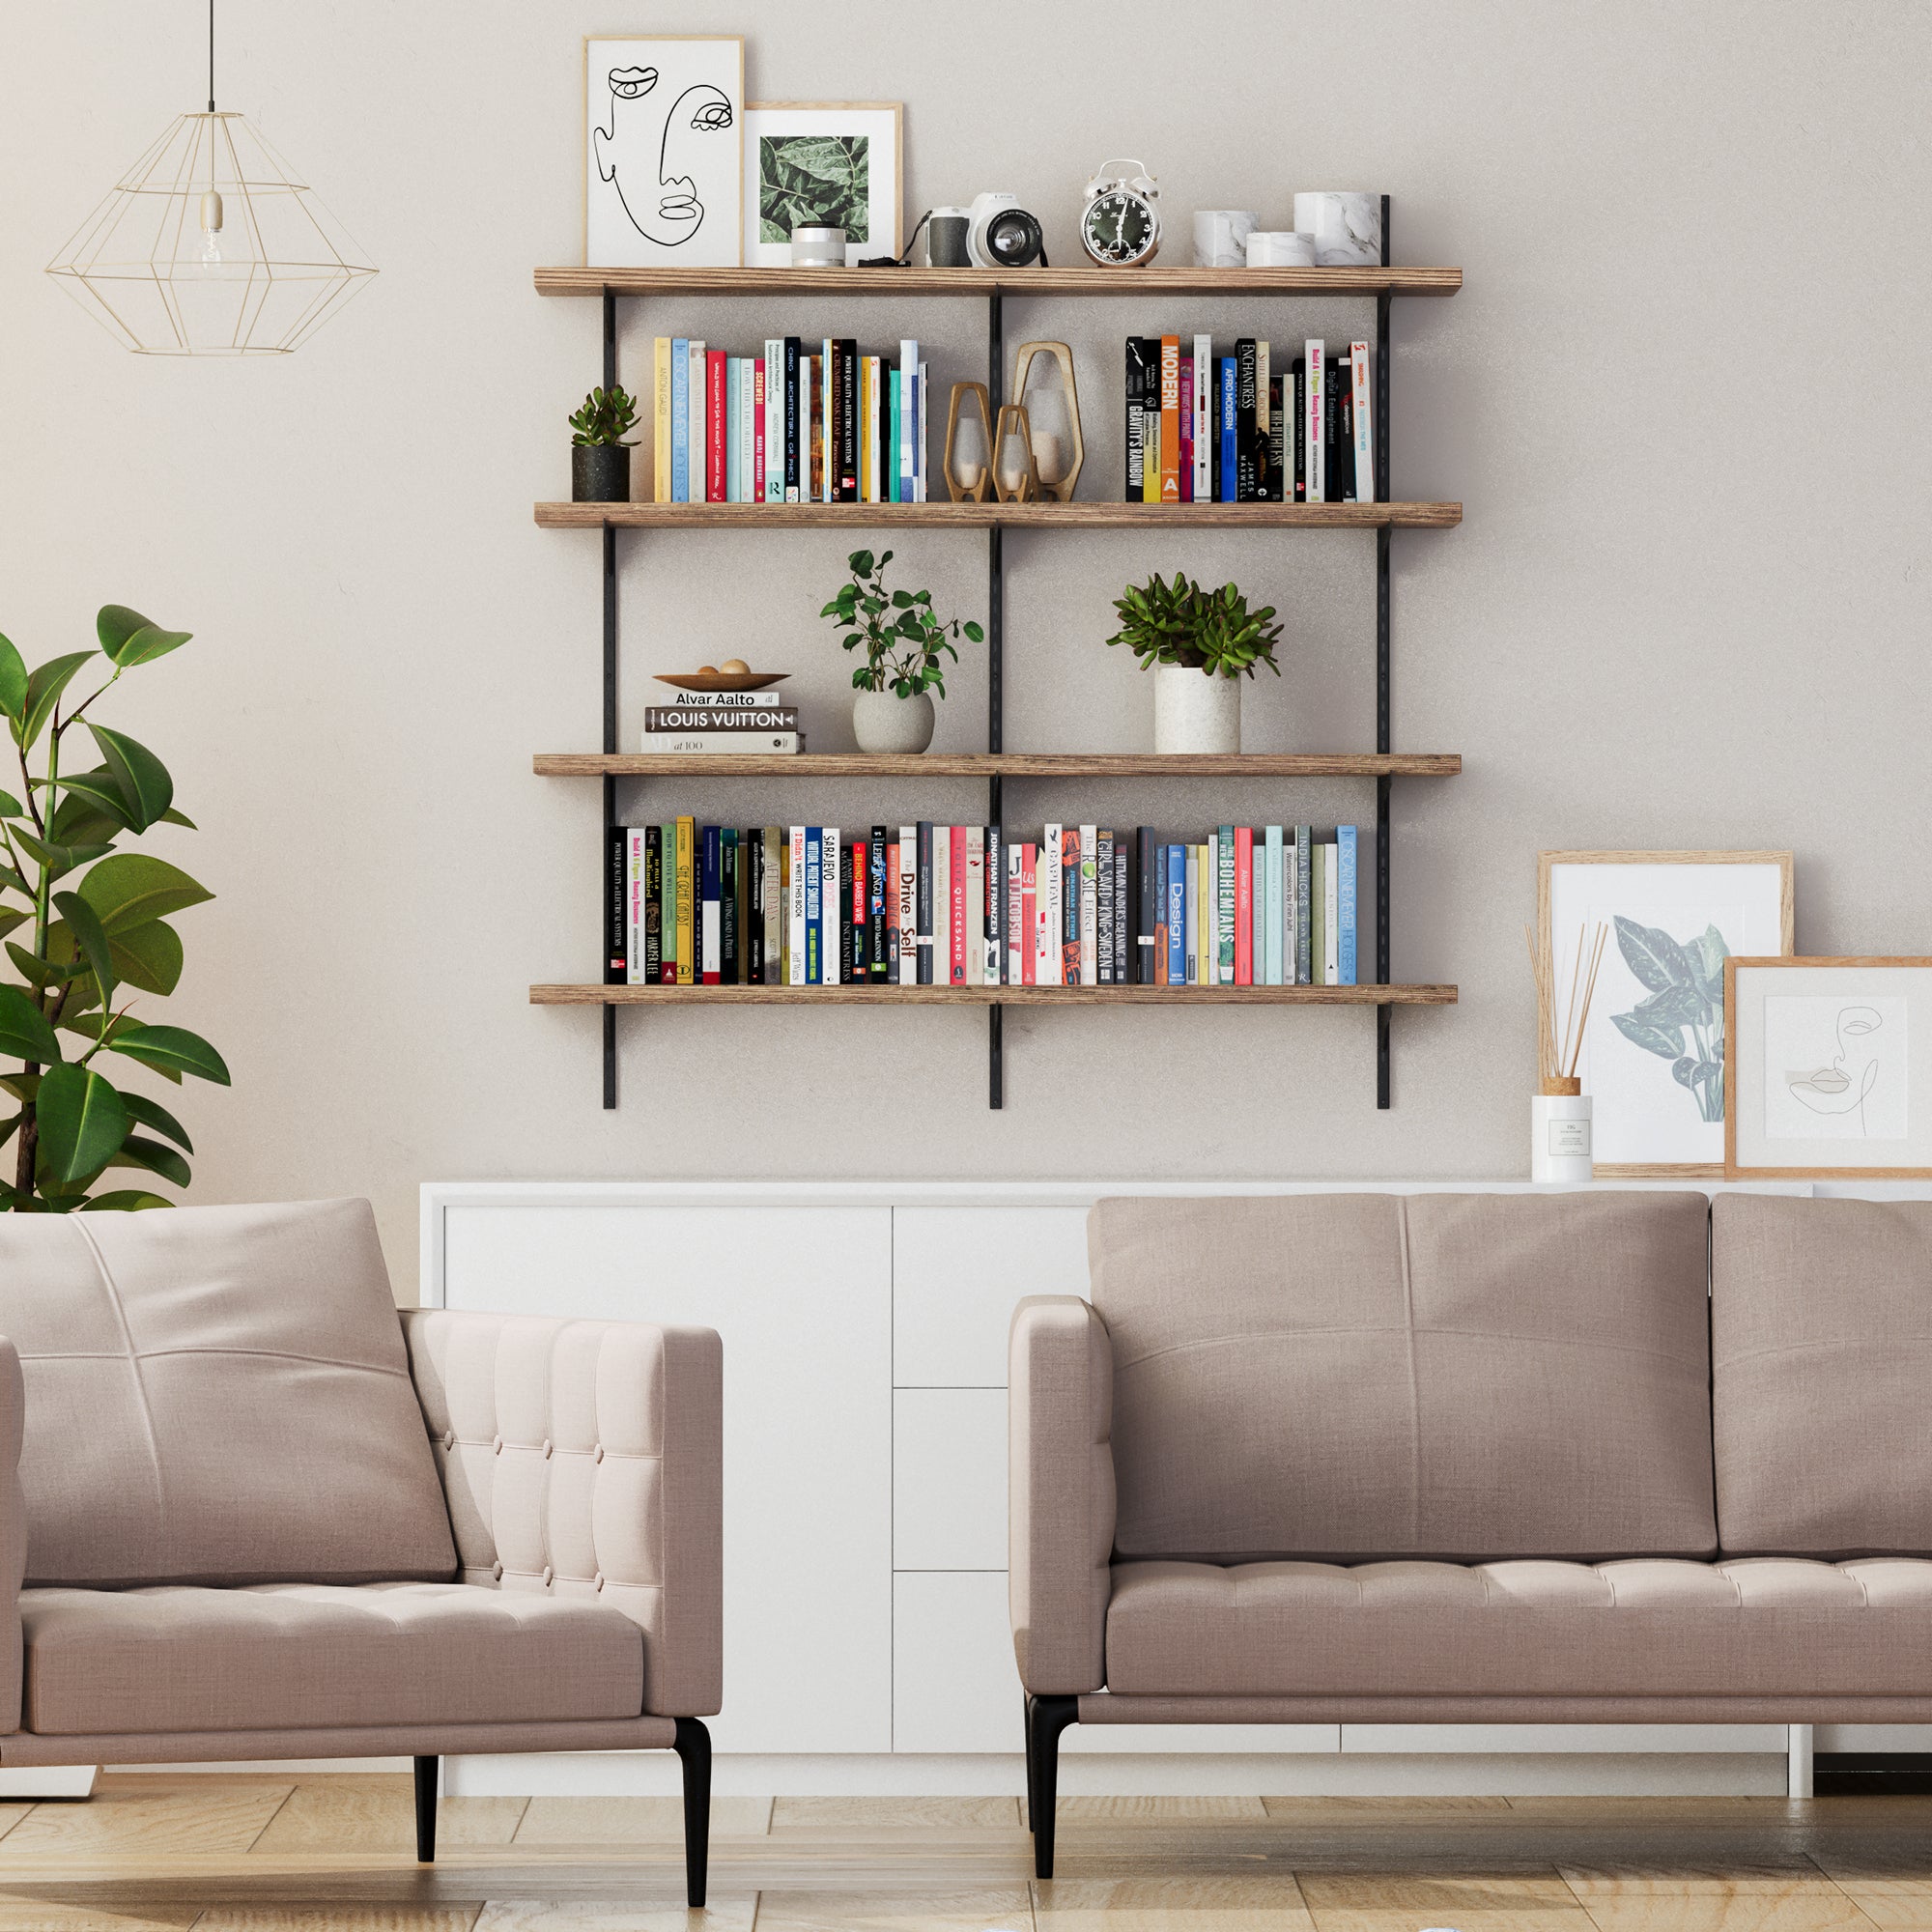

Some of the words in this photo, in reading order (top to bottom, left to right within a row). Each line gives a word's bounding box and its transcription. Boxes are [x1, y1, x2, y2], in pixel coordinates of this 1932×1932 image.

[674, 355, 686, 394] OSCAR
[1161, 345, 1179, 410] MODERN
[1225, 368, 1234, 391] AFRO
[1241, 345, 1256, 409] ENCHANTRESS
[1310, 376, 1320, 394] Figure
[1326, 372, 1336, 394] Digital
[1225, 392, 1234, 430] MODERN
[1310, 395, 1320, 415] Beauty
[674, 395, 686, 447] NIEMEYER
[1128, 406, 1144, 447] GRAVITY'S
[1326, 398, 1336, 444] Entanglement
[674, 448, 686, 491] HOUSES
[1128, 448, 1144, 487] RAINBOW
[1164, 478, 1178, 492] A
[675, 693, 712, 705] Alvar
[715, 693, 754, 705] Aalto
[660, 712, 708, 727] LOUIS
[711, 712, 783, 727] VUITTON
[673, 742, 683, 751] at
[685, 742, 703, 751] 100
[666, 851, 673, 860] TO
[808, 841, 819, 865] VIRTUAL
[823, 836, 835, 881] SARAJEVO
[872, 843, 883, 866] LEPER
[1298, 837, 1308, 867] INDIA
[1341, 841, 1353, 878] OSCAR
[632, 864, 640, 879] Figure
[676, 866, 690, 878] THE
[766, 862, 779, 895] AFTER
[808, 866, 819, 887] PATIENT
[854, 854, 864, 880] BEHIND
[1115, 856, 1126, 889] HITMAN
[1285, 852, 1293, 893] Watercolors
[632, 881, 640, 900] Beauty
[676, 880, 690, 900] GREAT
[854, 881, 864, 906] BARBED
[872, 867, 883, 895] TANGO
[900, 873, 916, 914] Drive
[1298, 871, 1308, 906] HICKS
[766, 896, 779, 922] DAYS
[808, 888, 819, 920] SIMULATION
[823, 883, 835, 908] ROSES
[1115, 890, 1126, 920] ANDERS
[1219, 860, 1235, 943] BOHEMIANS
[1285, 894, 1293, 902] by
[1341, 879, 1353, 928] NIEMEYER
[676, 903, 690, 926] GATSBY
[854, 907, 864, 923] WIRE
[1009, 891, 1020, 943] JACOBSON
[1169, 883, 1183, 949] Design
[647, 937, 659, 962] HARPER
[900, 927, 916, 957] Self
[1115, 922, 1125, 957] MEANING
[1341, 929, 1353, 970] HOUSES
[647, 964, 659, 975] LEE
[790, 952, 802, 963] Jeff
[792, 964, 802, 980] Watts
